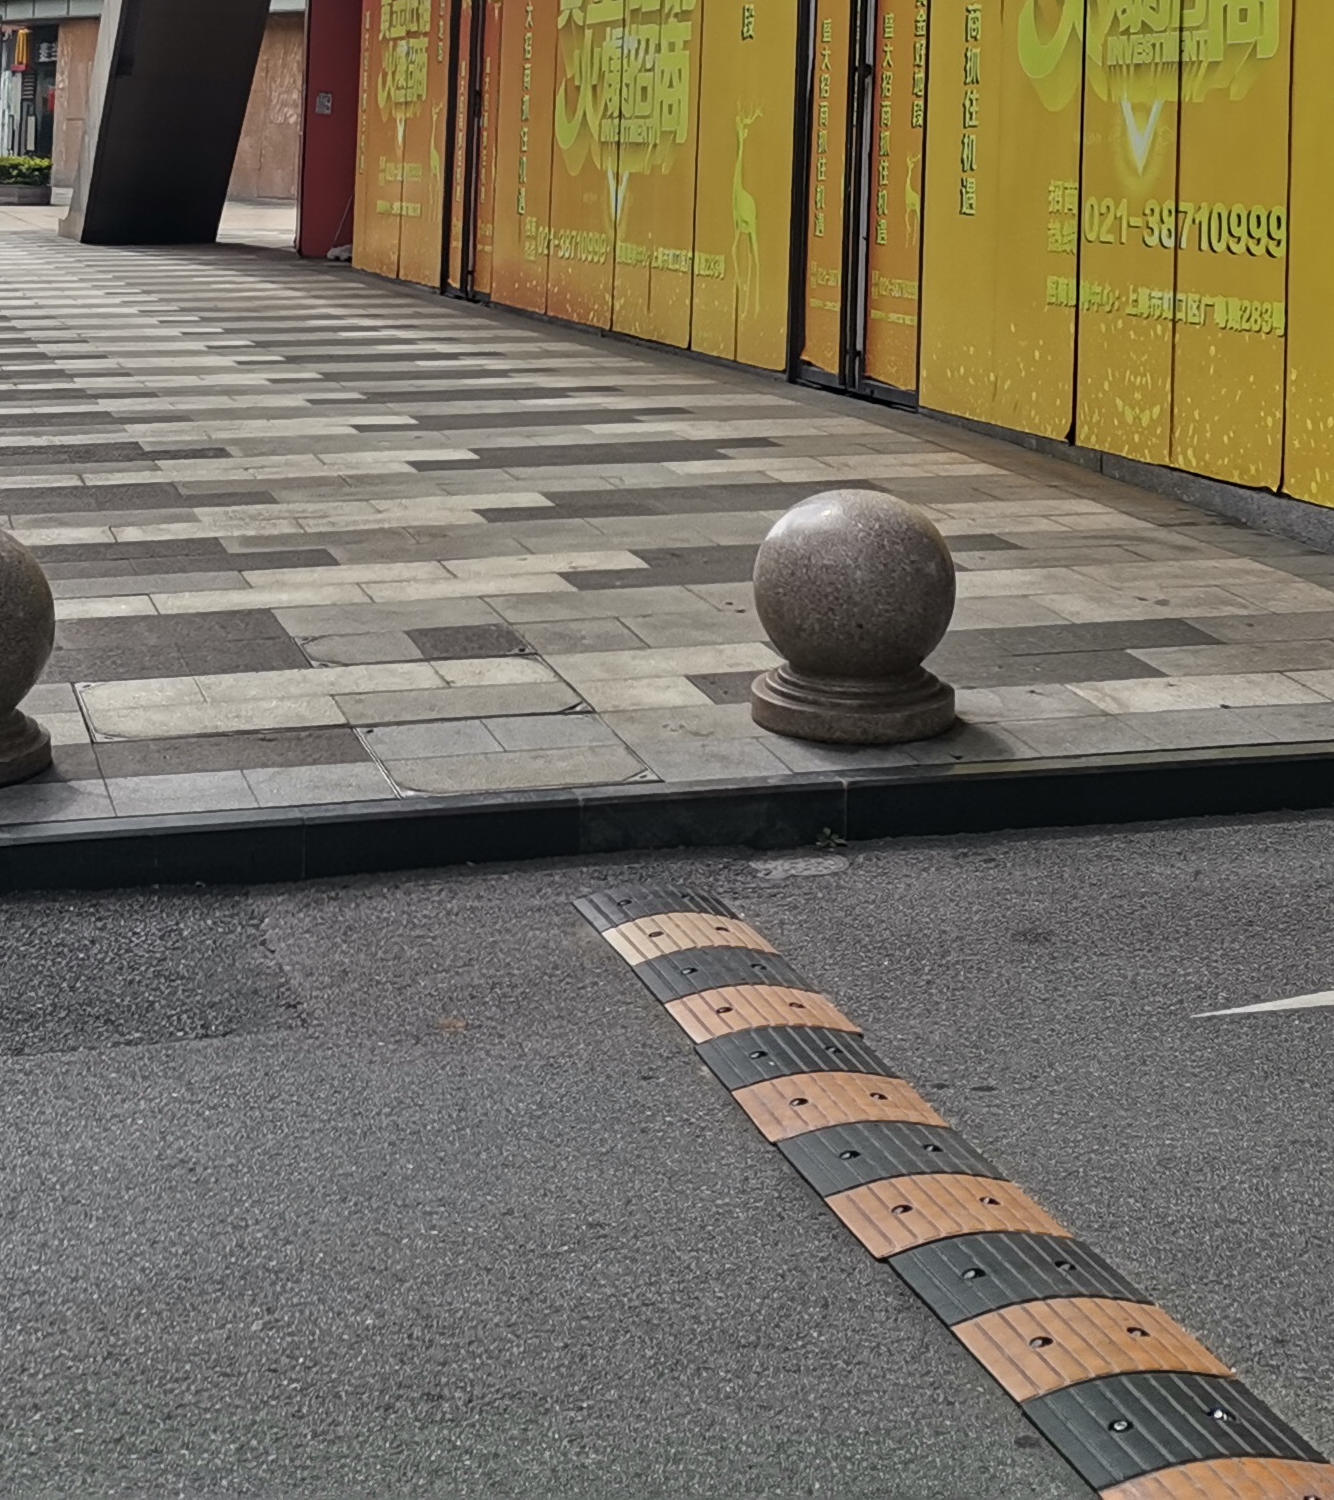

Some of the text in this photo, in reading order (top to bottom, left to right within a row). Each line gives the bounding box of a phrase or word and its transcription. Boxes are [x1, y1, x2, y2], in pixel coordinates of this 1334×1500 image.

[555, 17, 692, 150] 火爆招商
[1084, 196, 1286, 258] 021-38710999
